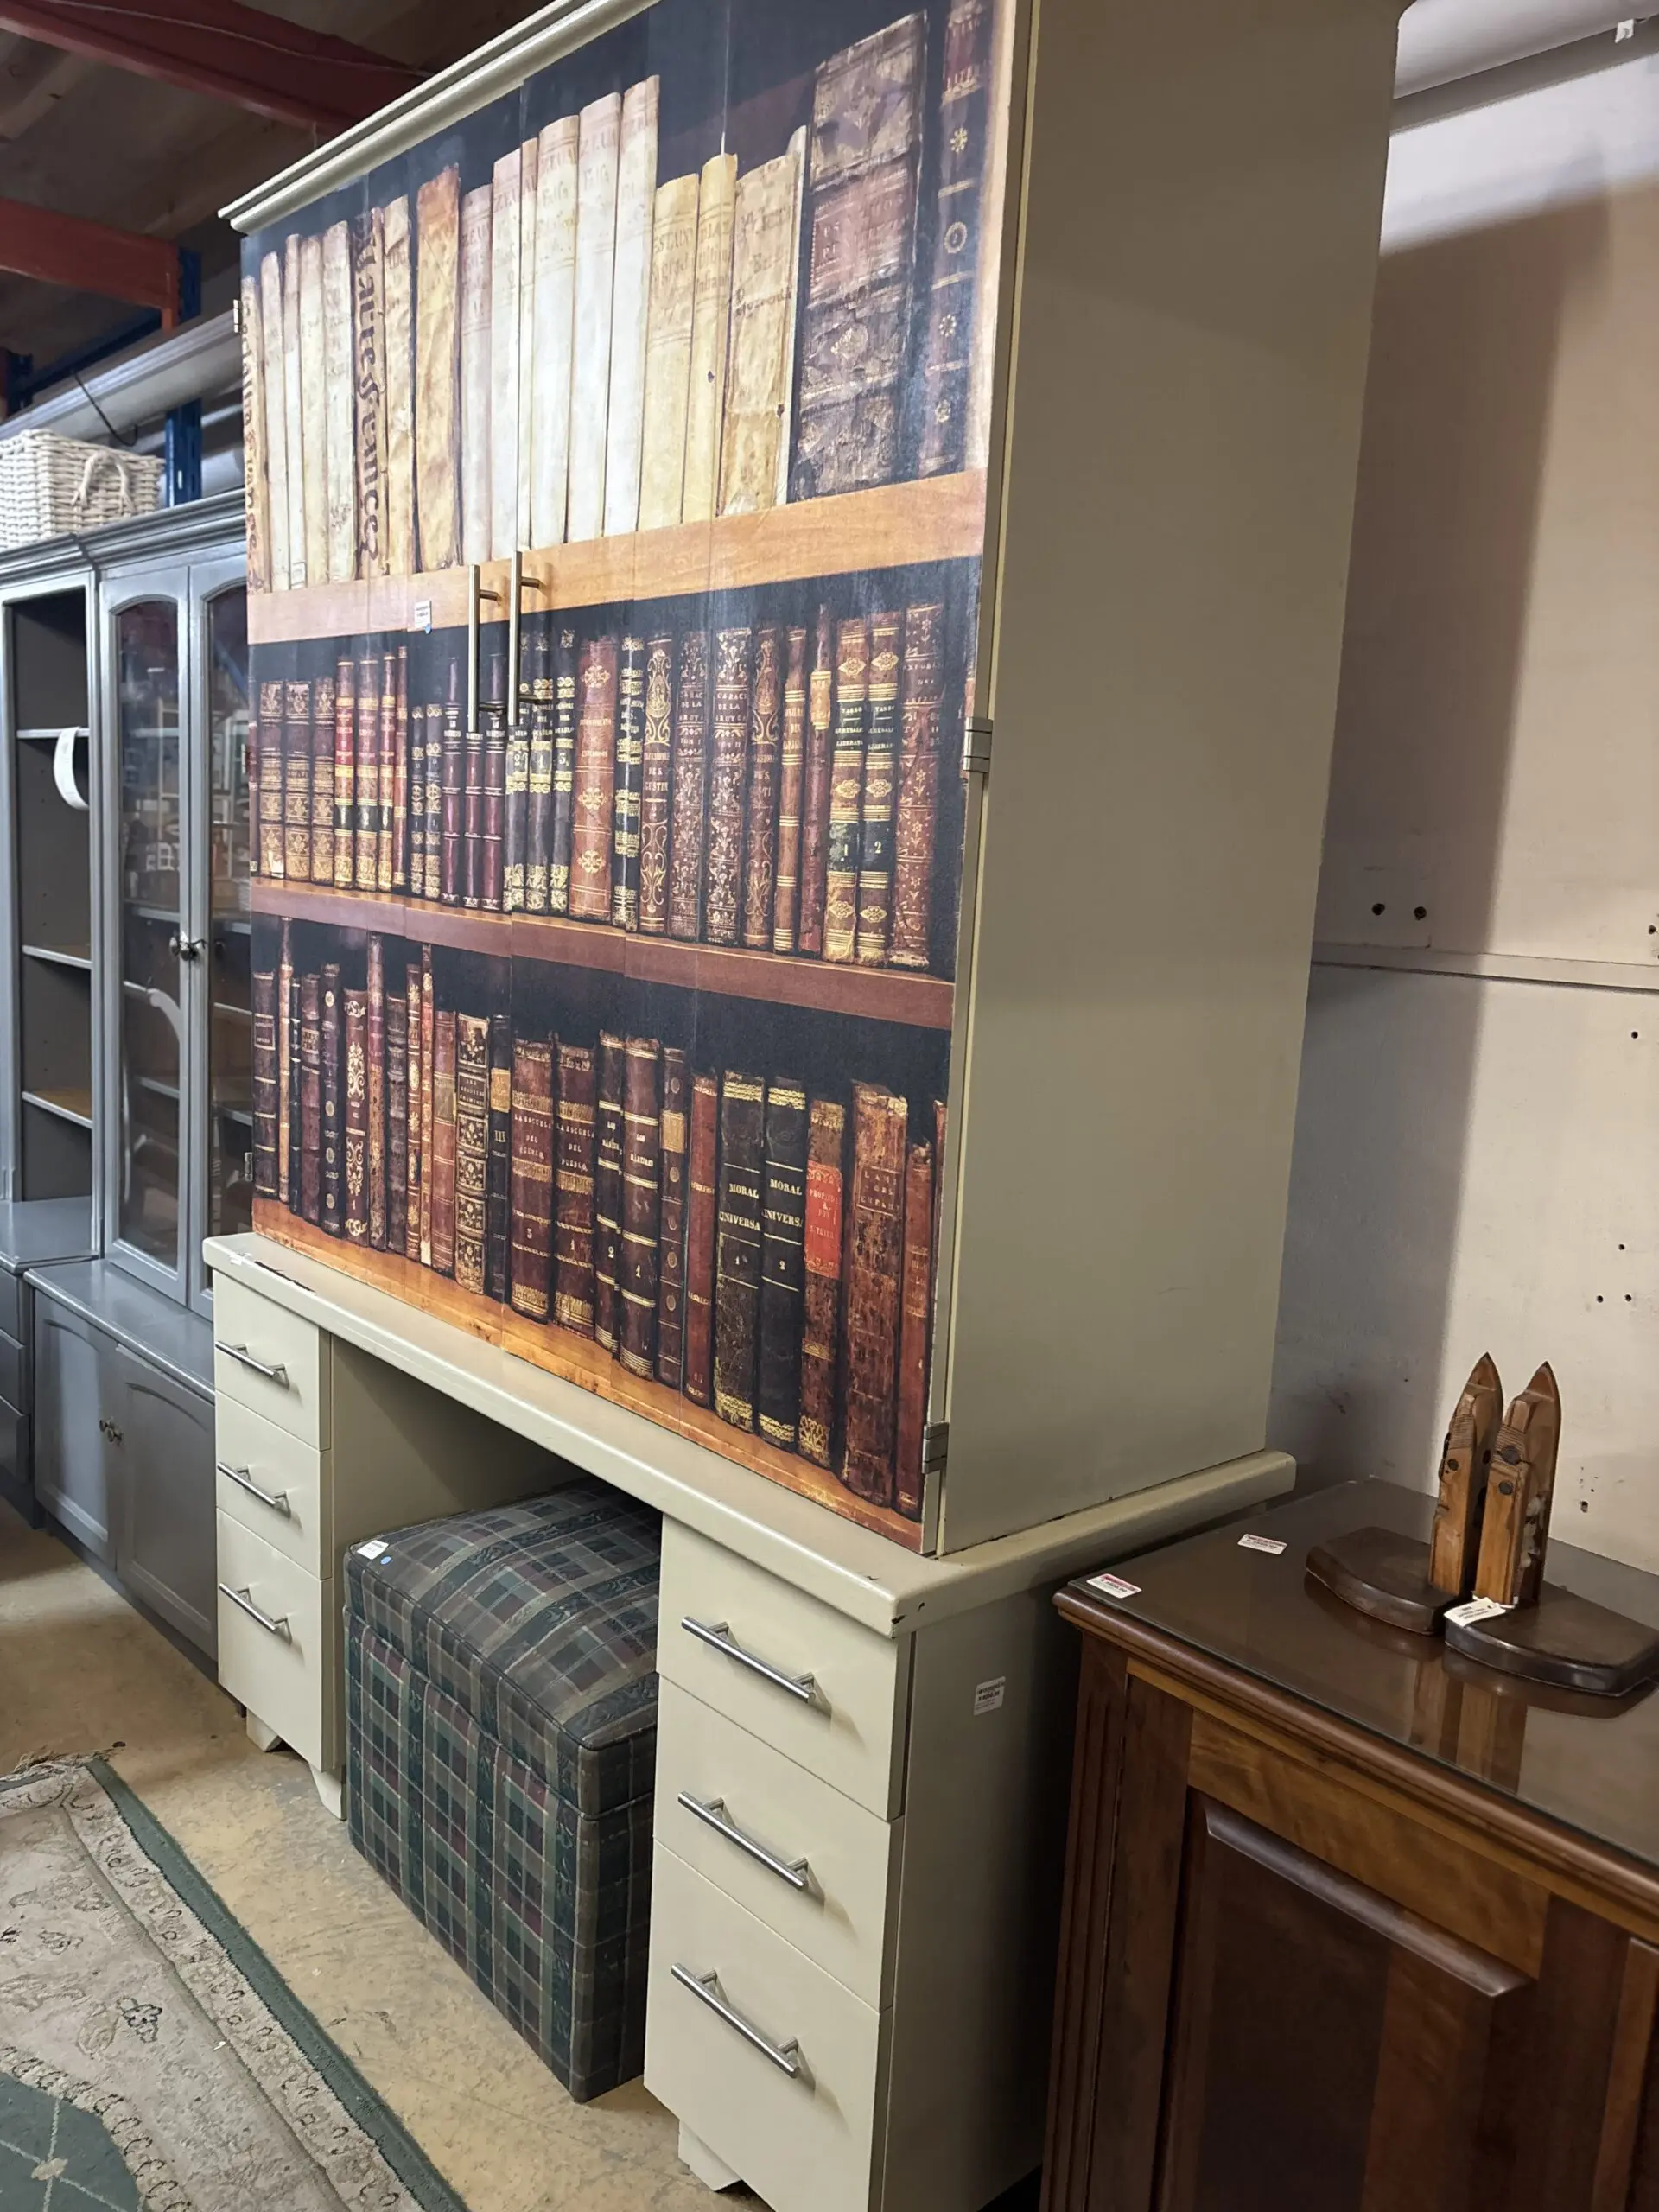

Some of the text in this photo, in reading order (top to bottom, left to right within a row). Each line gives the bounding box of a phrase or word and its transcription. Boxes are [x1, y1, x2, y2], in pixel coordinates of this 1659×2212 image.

[874, 840, 882, 854] 2
[568, 1143, 582, 1153] DEL
[728, 1183, 760, 1199] MORAL
[769, 1178, 802, 1196] MORAL
[607, 1245, 614, 1258] 2
[735, 1255, 740, 1265] 1
[779, 1260, 786, 1270] 2
[635, 1264, 642, 1278] 1
